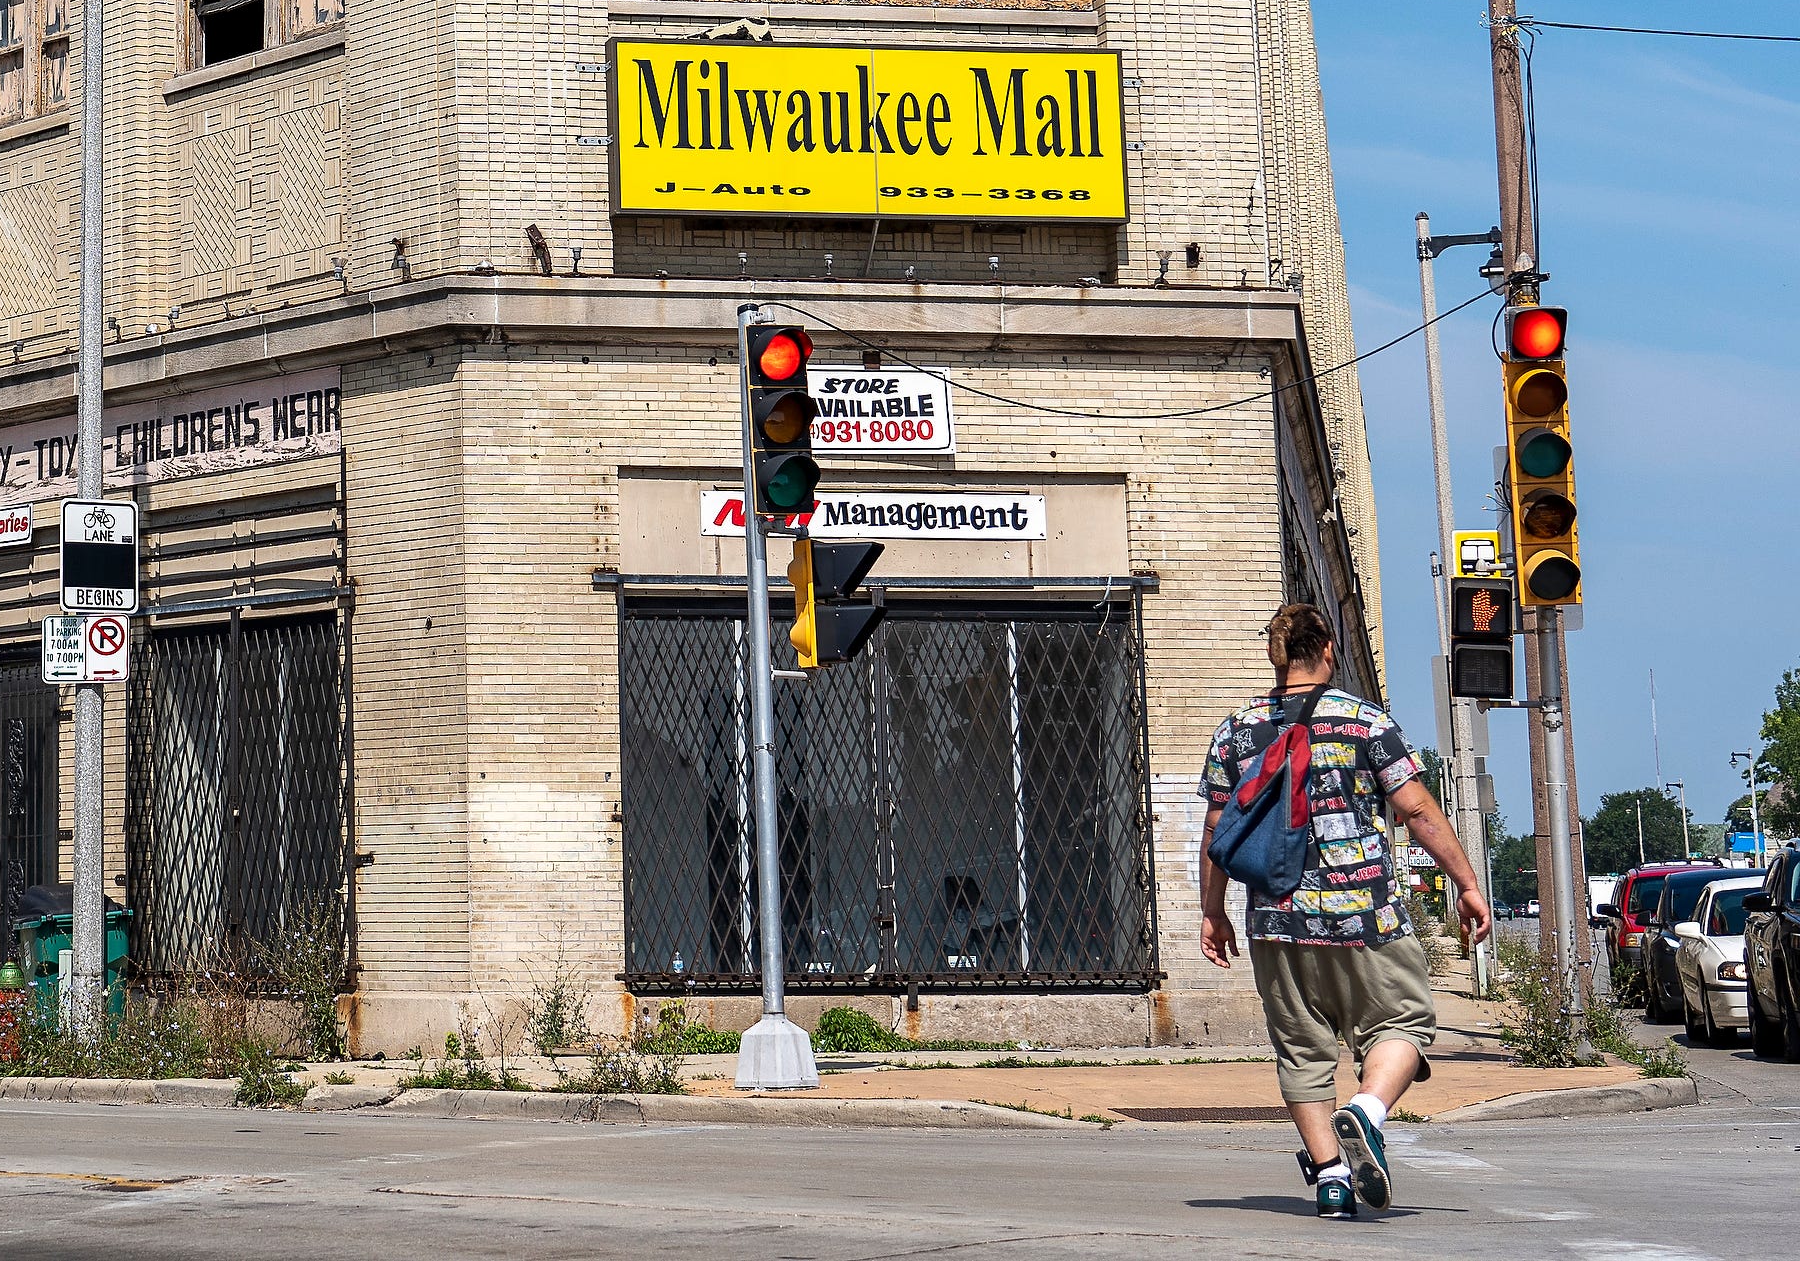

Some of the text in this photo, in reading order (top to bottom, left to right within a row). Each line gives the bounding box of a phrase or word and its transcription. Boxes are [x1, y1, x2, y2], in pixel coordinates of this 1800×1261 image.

[632, 59, 1104, 158] Milwaukee Mall
[879, 185, 1092, 201] 933-3368
[819, 377, 899, 394] STORE
[33, 433, 80, 481] TOY
[116, 397, 261, 468] CHILDREN'S
[272, 386, 341, 442] WEAR
[823, 501, 1028, 531] Management
[84, 529, 115, 542] LANE
[76, 589, 123, 606] BEGINS
[50, 618, 77, 636] 1 HOUR
[56, 628, 82, 636] PARKING
[1312, 722, 1332, 735] TOM
[1327, 871, 1348, 884] TOM
